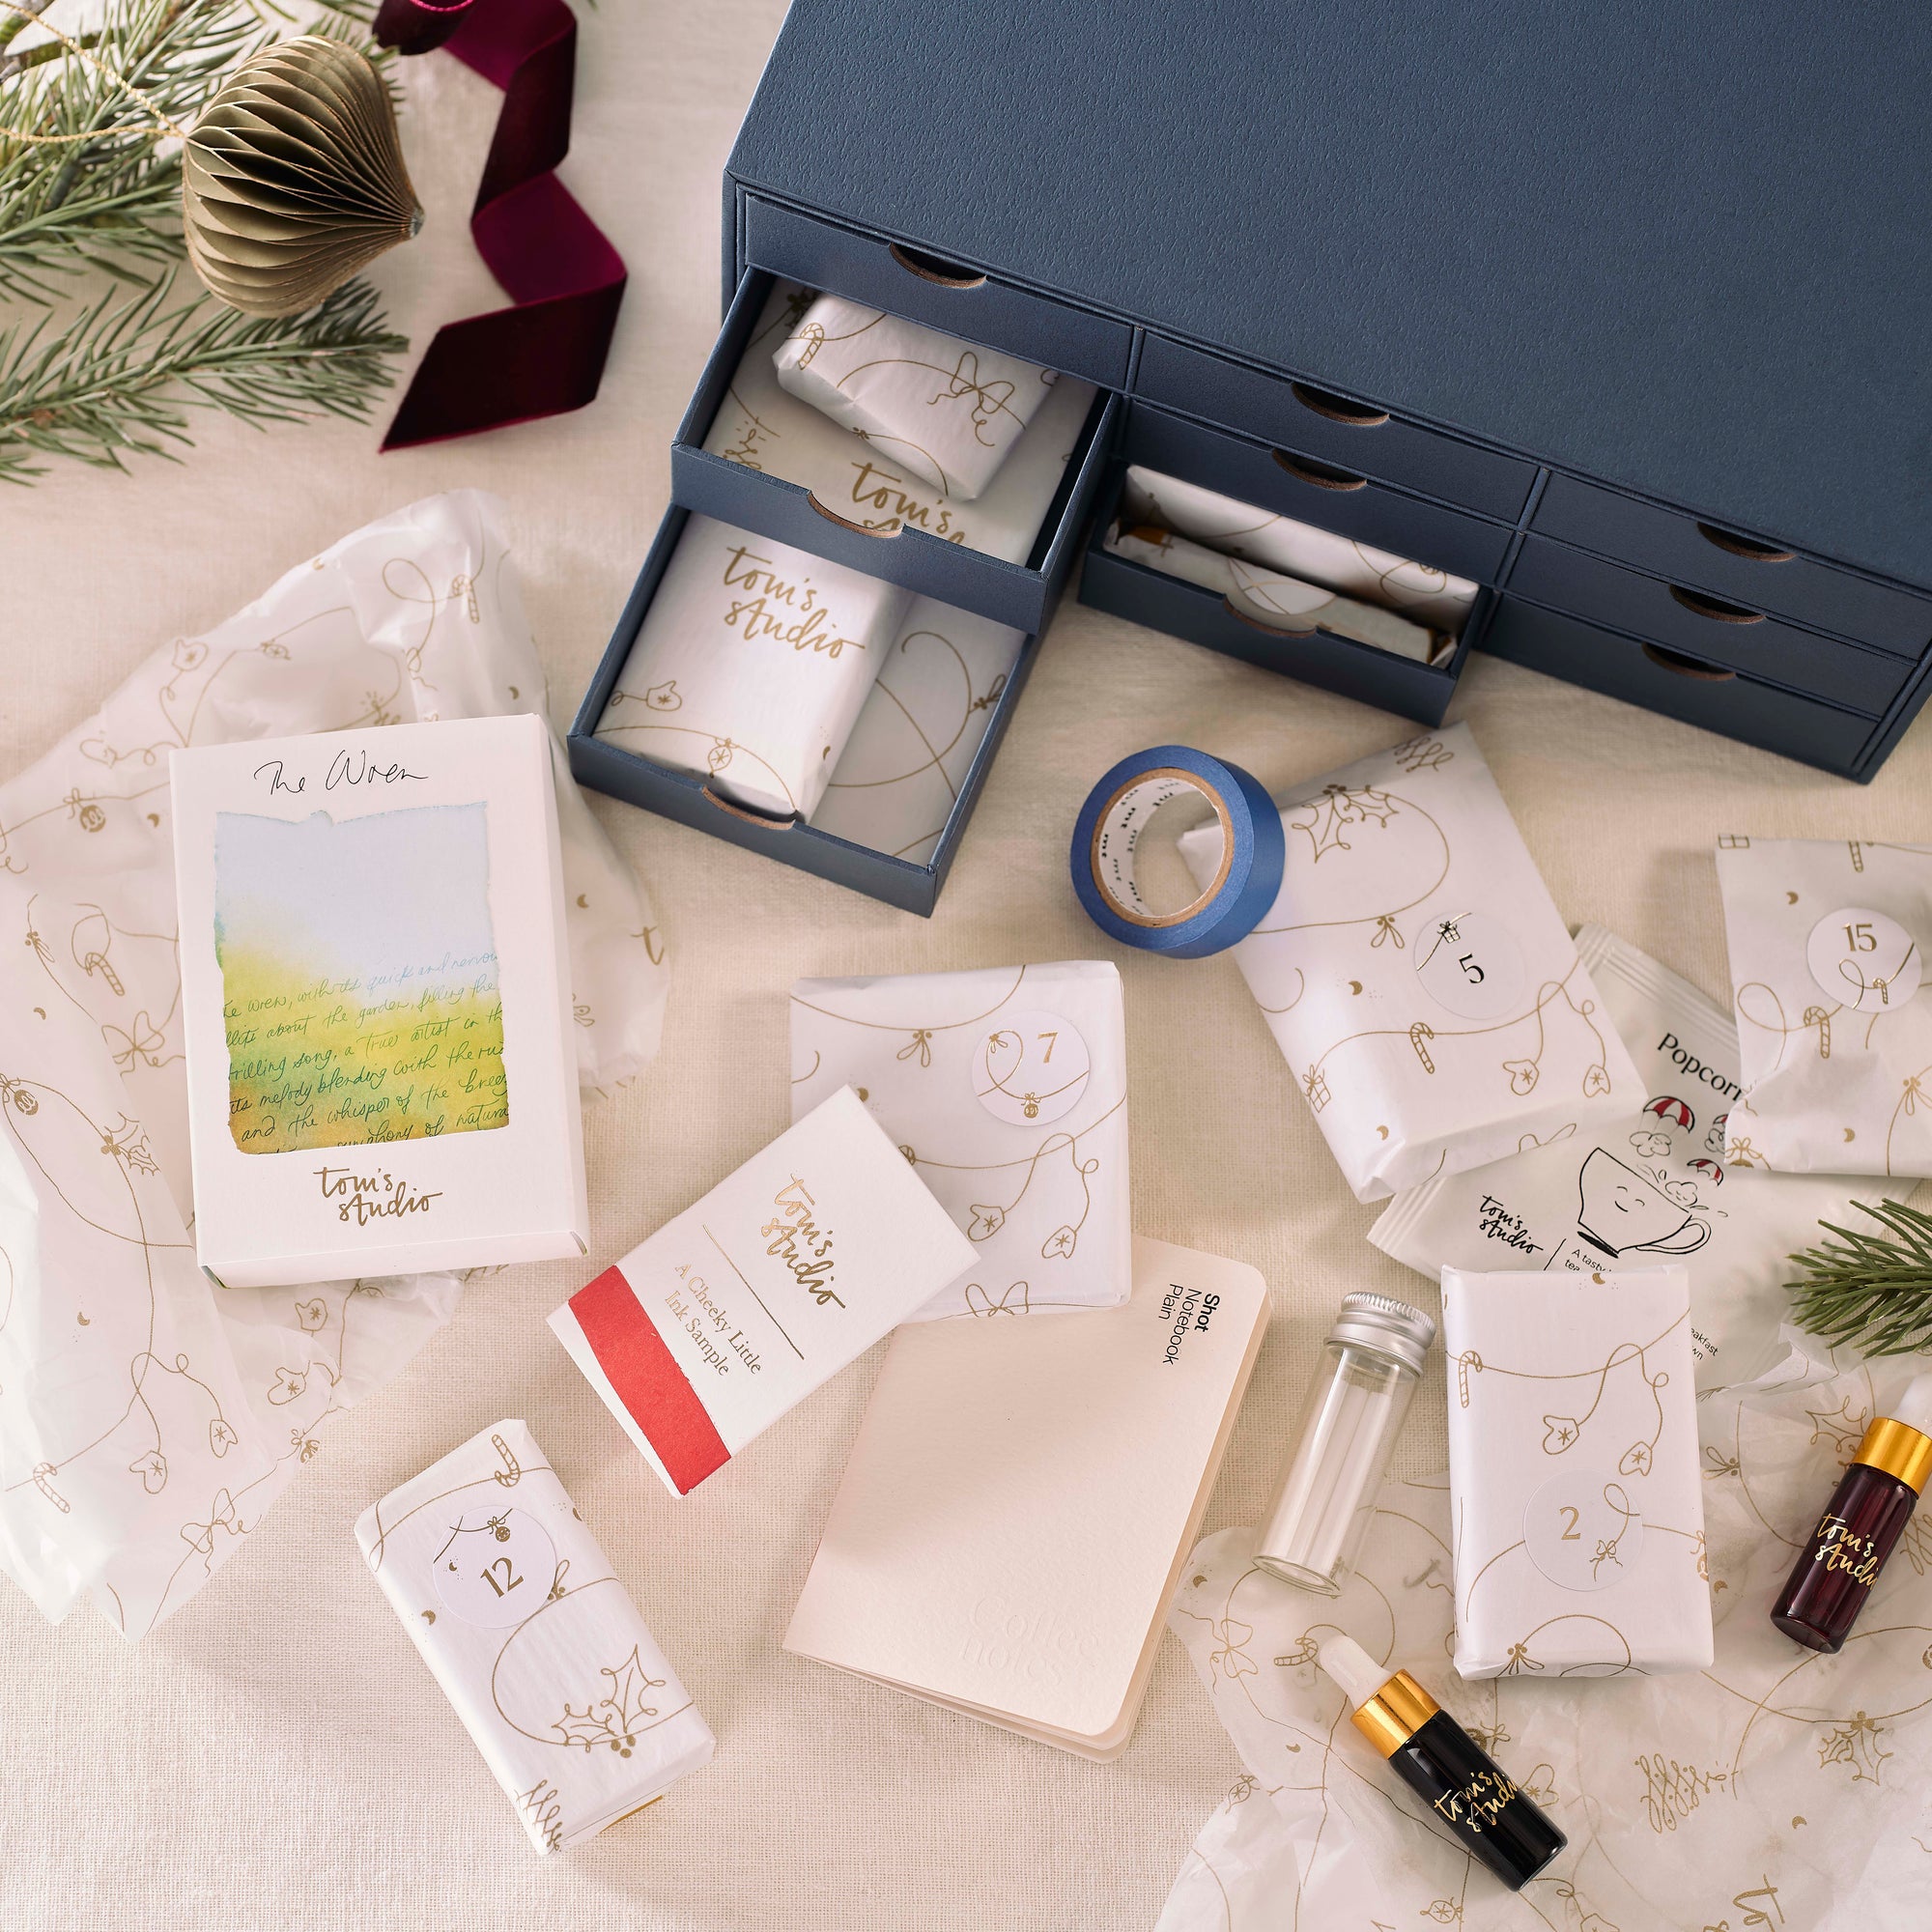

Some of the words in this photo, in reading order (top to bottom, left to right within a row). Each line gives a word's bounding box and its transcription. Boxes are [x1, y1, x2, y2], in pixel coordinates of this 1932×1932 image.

[851, 462, 952, 538] tom's
[724, 547, 817, 611] tom's
[724, 598, 866, 659] studio
[254, 760, 305, 795] The
[326, 750, 429, 790] Wren
[1842, 923, 1877, 952] 15
[298, 979, 334, 1002] with
[418, 952, 450, 974] and
[1459, 953, 1485, 983] 5
[267, 1015, 317, 1039] about
[325, 1005, 348, 1029] the
[416, 983, 465, 1012] filling
[469, 974, 496, 998] the
[344, 1045, 355, 1056] a
[411, 1014, 462, 1043] artist
[464, 1013, 479, 1030] in
[1038, 1032, 1058, 1064] 7
[229, 1095, 253, 1115] its
[260, 1083, 313, 1110] melody
[317, 1065, 387, 1094] blending
[393, 1043, 438, 1075] with
[447, 1041, 473, 1068] the
[242, 1116, 275, 1143] and
[288, 1104, 318, 1136] the
[327, 1096, 390, 1123] whisper
[396, 1085, 413, 1114] of
[421, 1078, 448, 1110] the
[425, 1114, 445, 1138] of
[313, 1167, 393, 1198] tom's
[339, 1181, 443, 1227] studio
[775, 1174, 834, 1257] tom's
[1479, 1195, 1522, 1230] tom's
[1479, 1218, 1544, 1254] studio
[1572, 1248, 1580, 1258] A
[761, 1217, 845, 1308] studio
[674, 1264, 693, 1280] A
[688, 1275, 731, 1333] Cheeky
[727, 1330, 761, 1375] Little
[1158, 1284, 1183, 1320] Plain
[1194, 1293, 1220, 1332] Shot
[665, 1291, 689, 1321] Ink
[685, 1317, 729, 1377] Sample
[1162, 1288, 1202, 1365] Notebook
[1559, 1506, 1580, 1541] 2
[1817, 1513, 1874, 1557] tom's
[480, 1557, 524, 1598] 12
[1434, 1772, 1493, 1822] tom's
